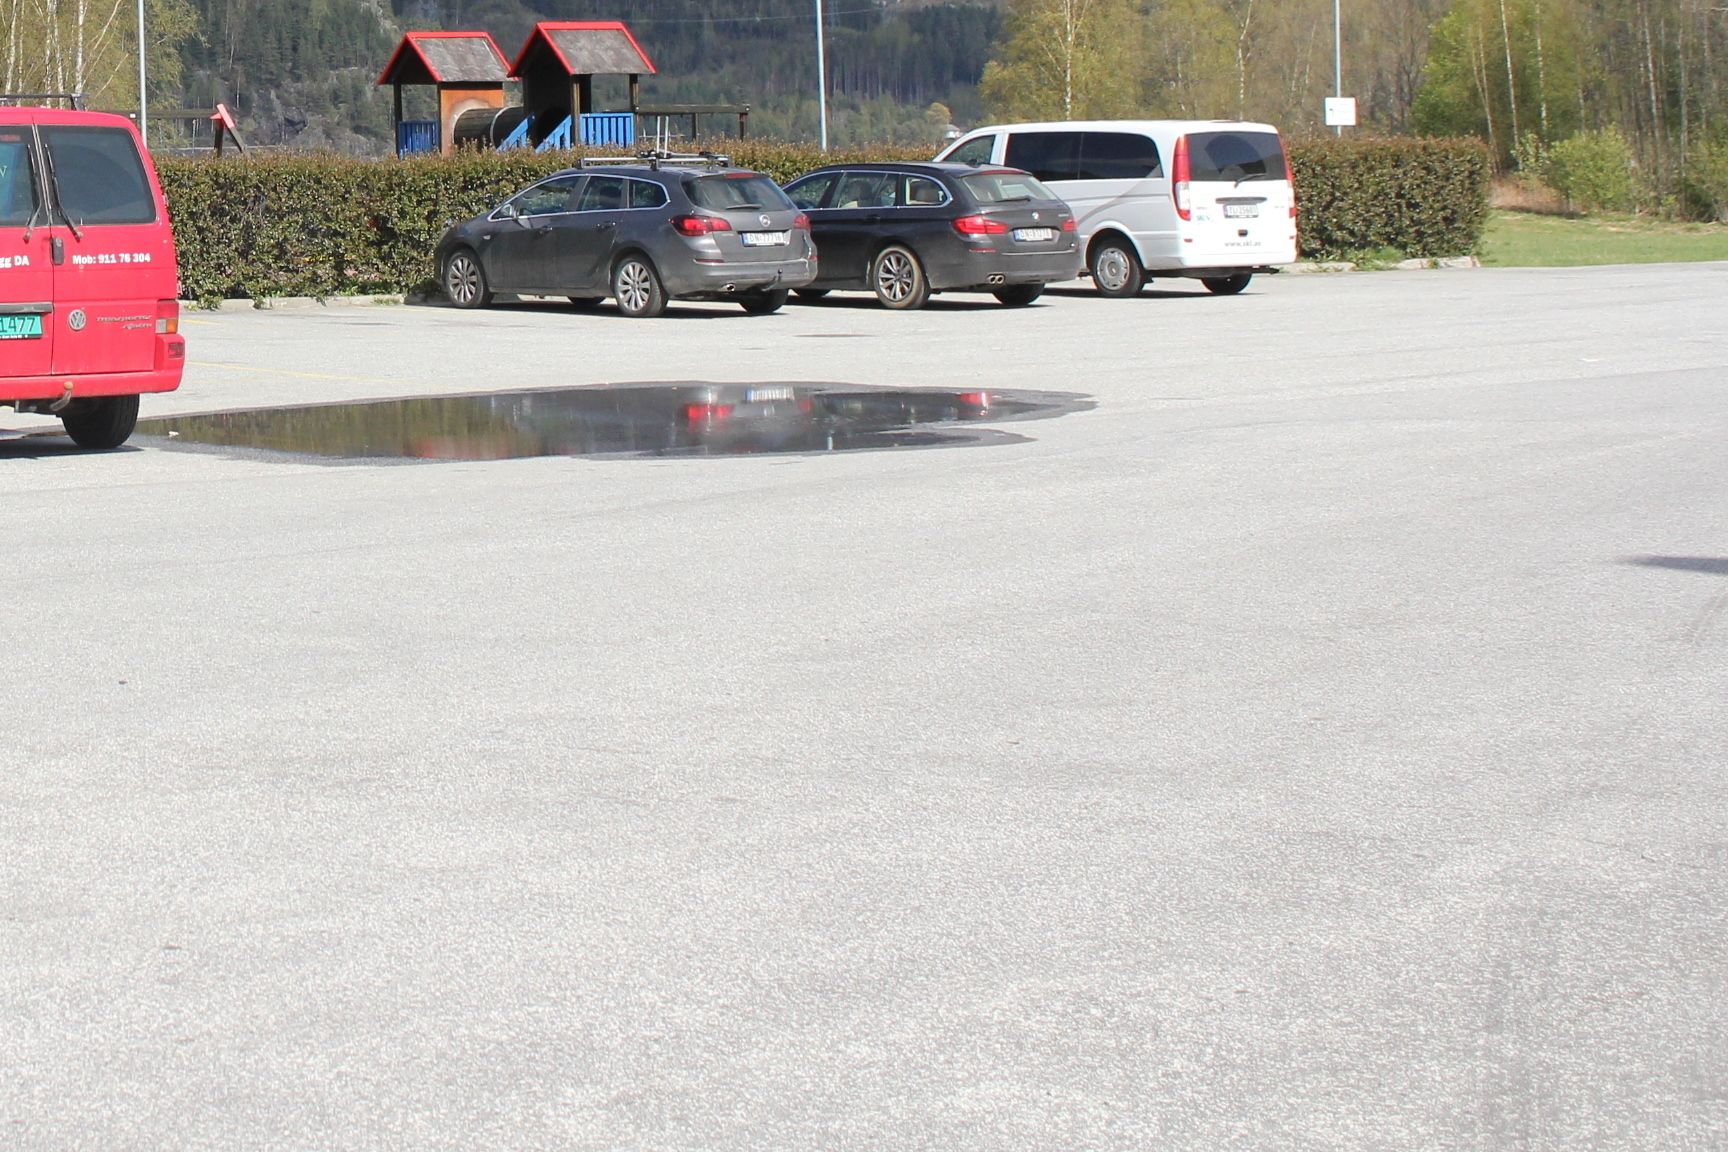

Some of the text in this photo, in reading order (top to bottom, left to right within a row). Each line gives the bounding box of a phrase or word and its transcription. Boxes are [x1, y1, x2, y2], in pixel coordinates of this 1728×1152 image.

[14, 255, 30, 266] DA
[72, 252, 151, 265] Mob: 911 76 304
